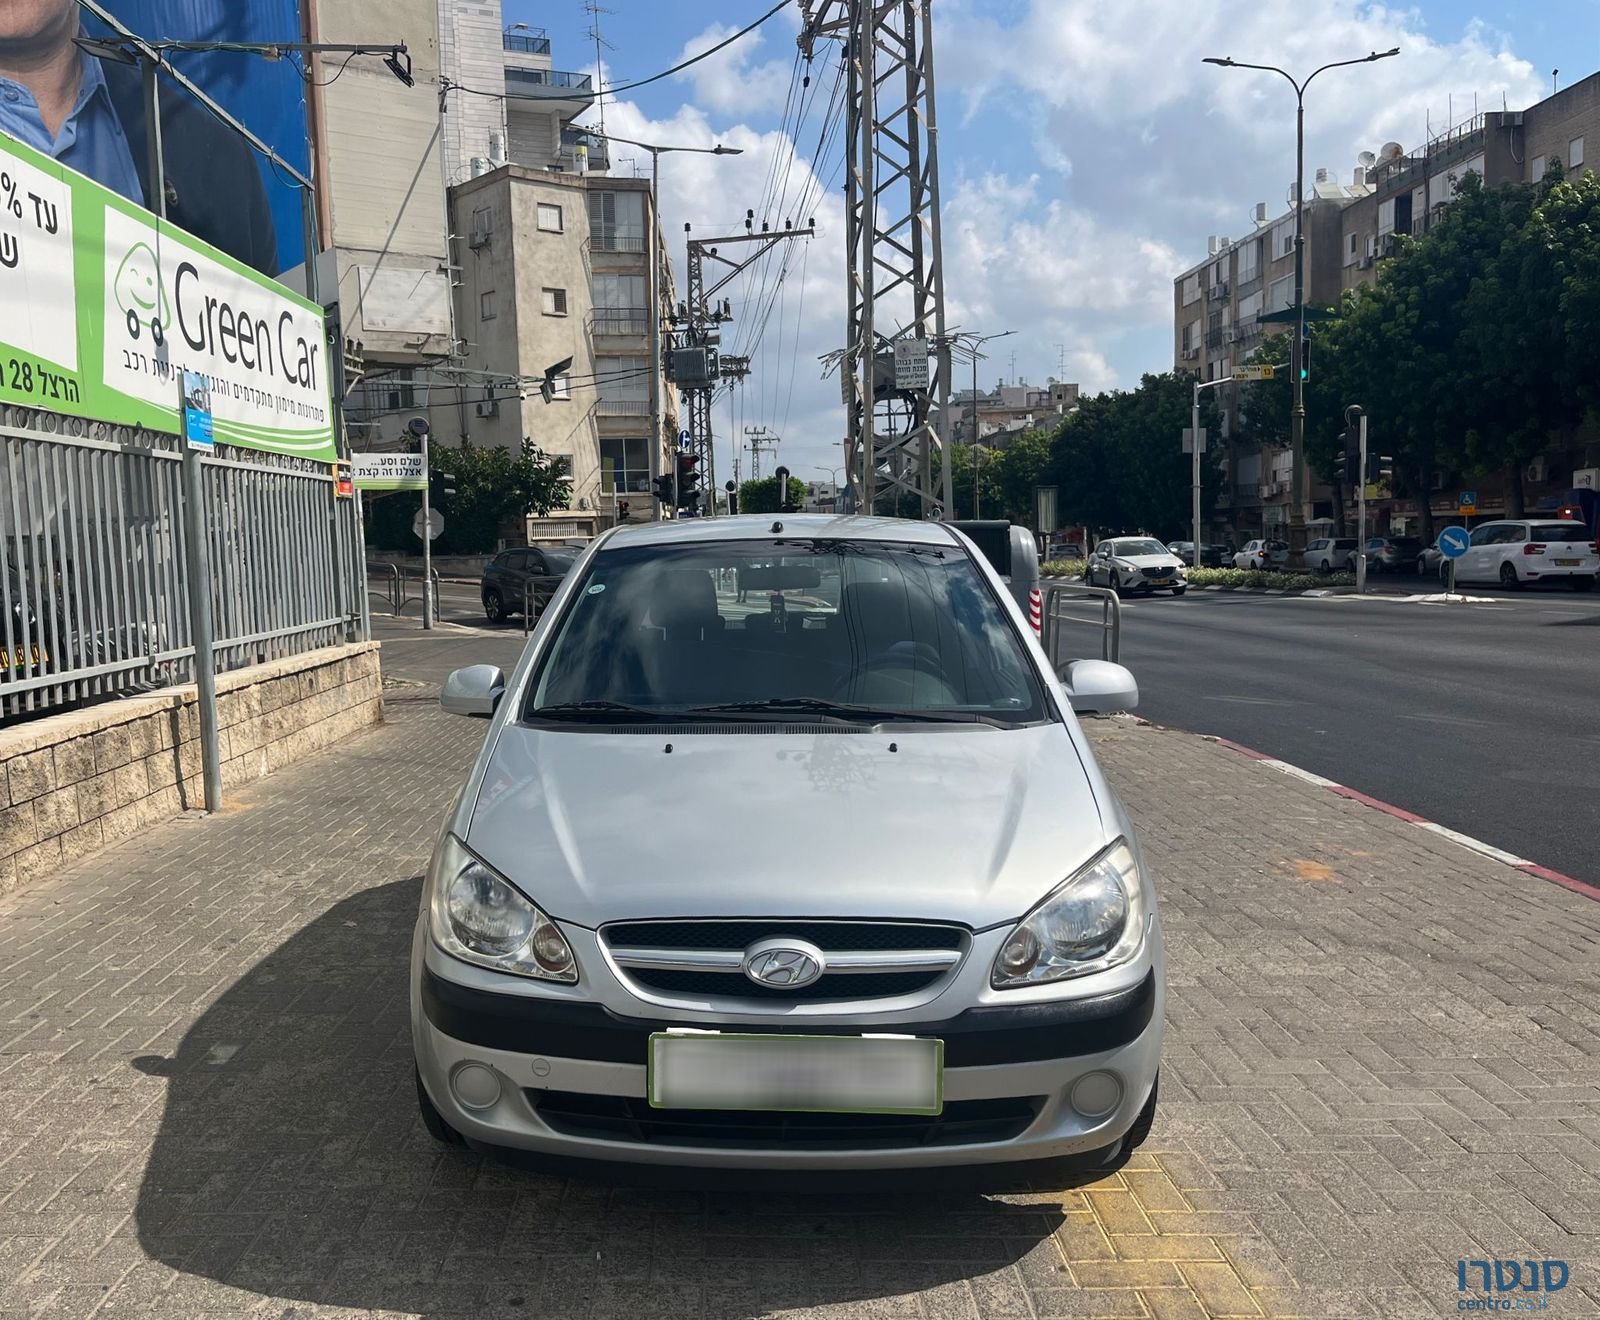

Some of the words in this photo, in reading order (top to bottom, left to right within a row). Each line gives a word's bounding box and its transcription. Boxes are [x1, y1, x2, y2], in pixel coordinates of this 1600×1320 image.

[28, 191, 58, 235] עד
[175, 261, 273, 376] Green
[278, 310, 317, 391] Car
[123, 349, 148, 374] רכב
[9, 358, 34, 393] 28
[37, 364, 80, 403] הרצל
[195, 371, 230, 397] והוג
[233, 383, 273, 409] מתקדמים
[275, 395, 296, 415] מימון
[297, 402, 325, 422] פתרונות
[359, 467, 379, 478] קצת
[382, 468, 393, 476] זה
[395, 467, 422, 476] אצלנו
[400, 456, 421, 466] שלם
